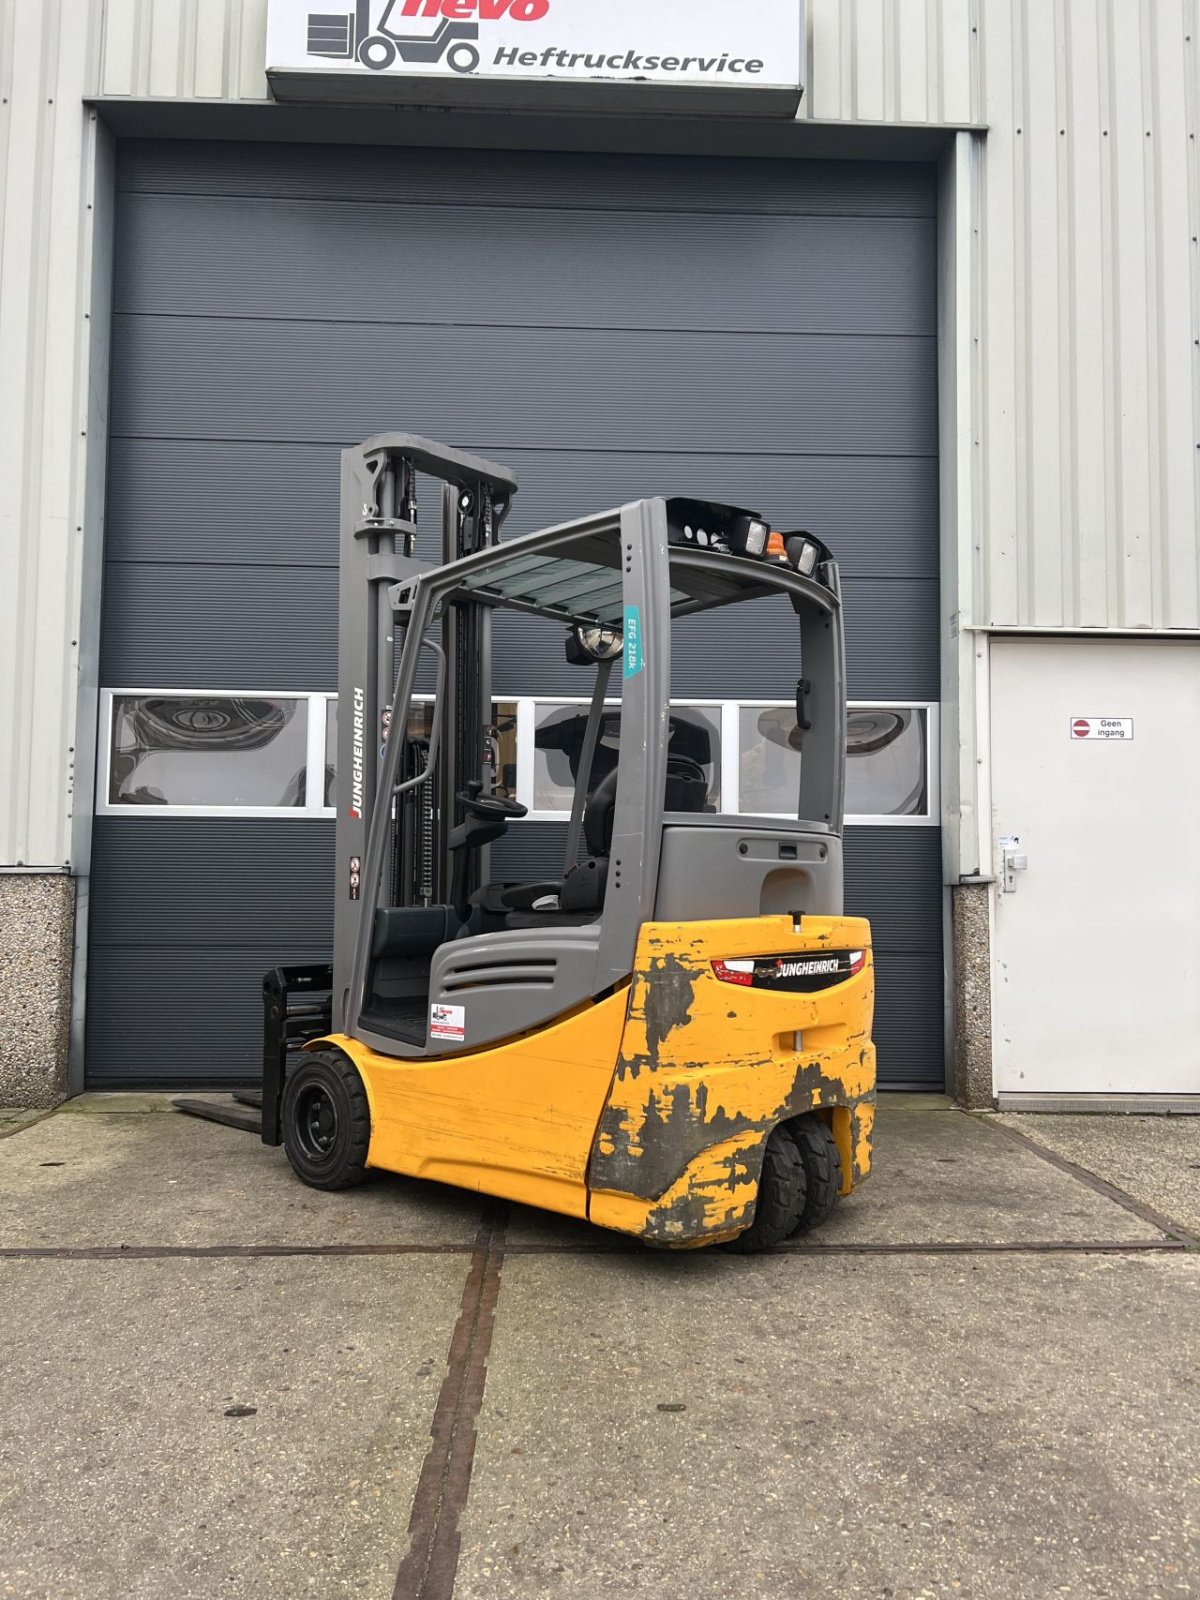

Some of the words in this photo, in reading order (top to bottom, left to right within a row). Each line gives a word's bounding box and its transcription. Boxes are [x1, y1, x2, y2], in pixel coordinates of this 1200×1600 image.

[400, 0, 550, 22] nevo
[492, 46, 764, 74] Heftruckservice
[628, 618, 637, 639] EFG
[628, 642, 637, 669] 218k
[1097, 729, 1125, 737] ingang
[349, 687, 364, 819] JUNGHEINRICH
[776, 959, 839, 978] JUNGHEINRICH
